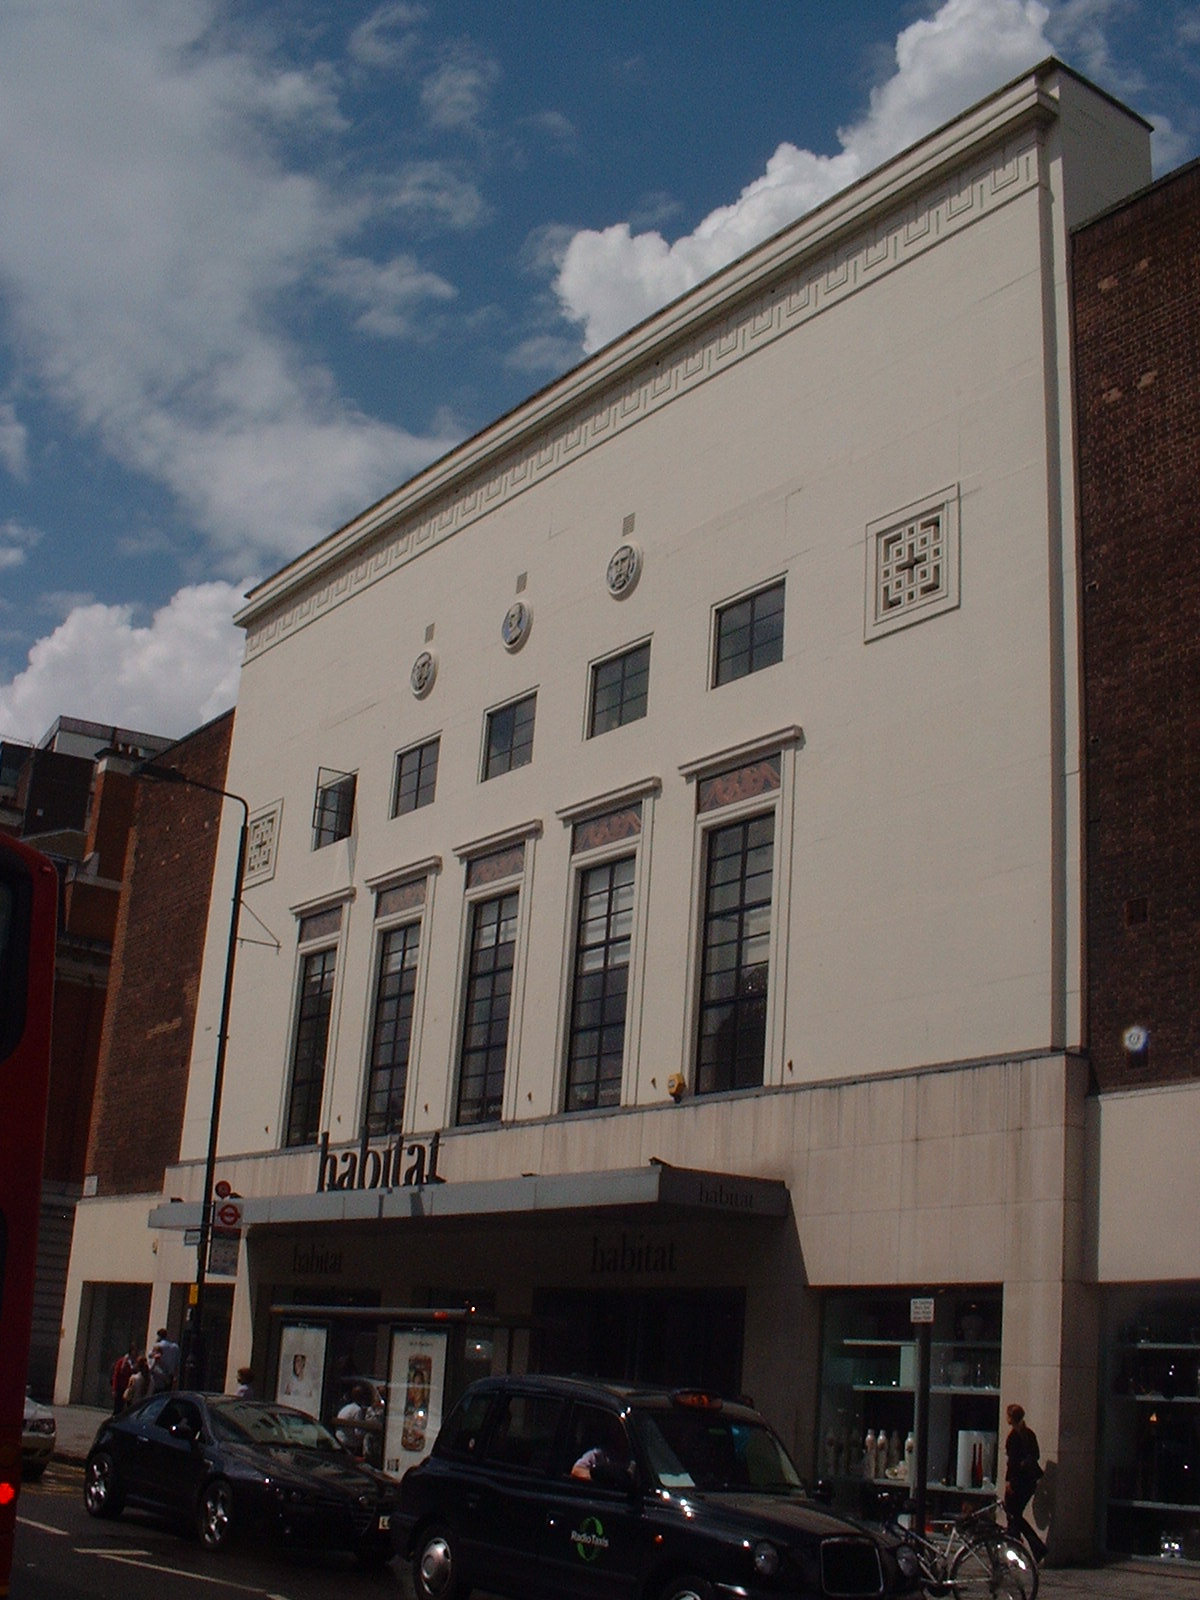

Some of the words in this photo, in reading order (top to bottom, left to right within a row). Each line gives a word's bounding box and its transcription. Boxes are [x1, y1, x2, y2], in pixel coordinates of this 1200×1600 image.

[316, 1125, 445, 1193] habitat
[292, 1243, 343, 1274] habitat
[591, 1232, 677, 1274] habitat
